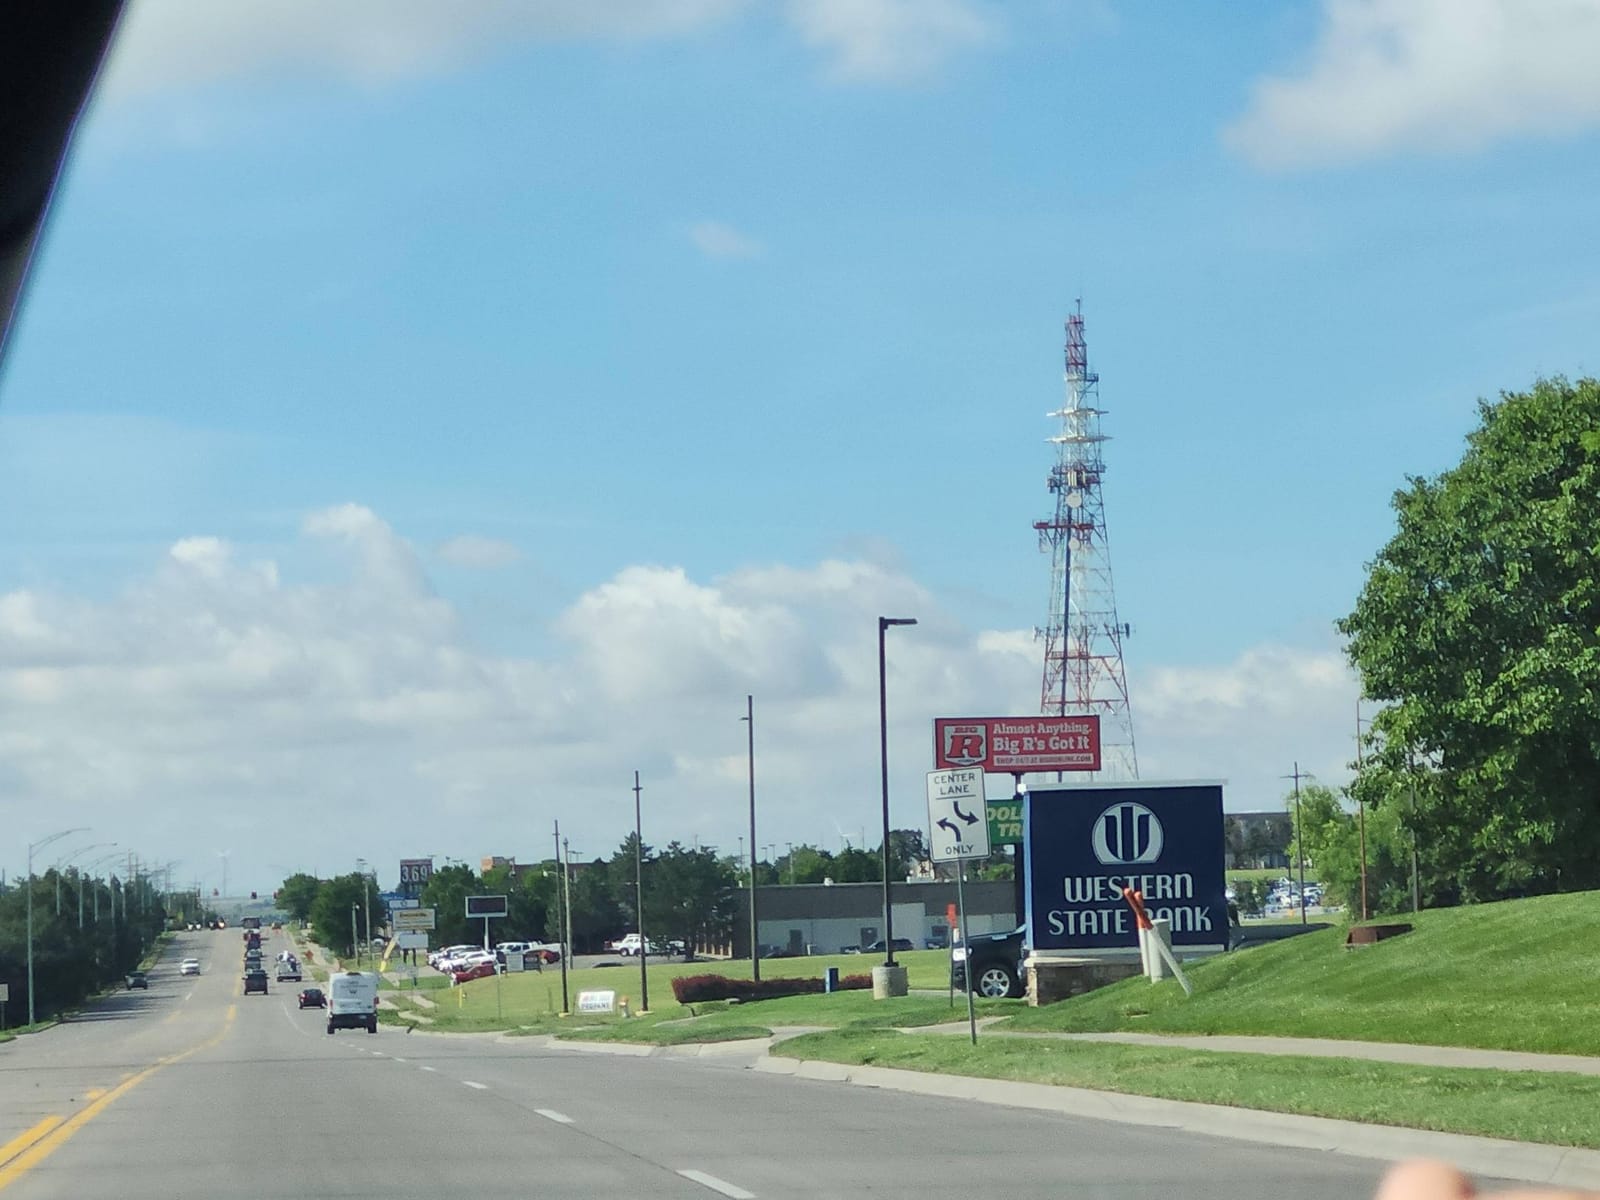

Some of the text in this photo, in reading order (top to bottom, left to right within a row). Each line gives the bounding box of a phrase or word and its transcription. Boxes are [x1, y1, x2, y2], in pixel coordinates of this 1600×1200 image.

[993, 722, 1092, 735] Almost Anything.
[946, 734, 983, 758] R
[993, 735, 1089, 754] Big R's Got It
[934, 773, 975, 784] CENTER
[940, 785, 970, 795] LANE
[987, 807, 1024, 820] DOL
[998, 823, 1024, 836] TR
[946, 845, 974, 855] ONLY
[1064, 873, 1193, 903] WESTERN
[1048, 905, 1212, 935] STATE ANK
